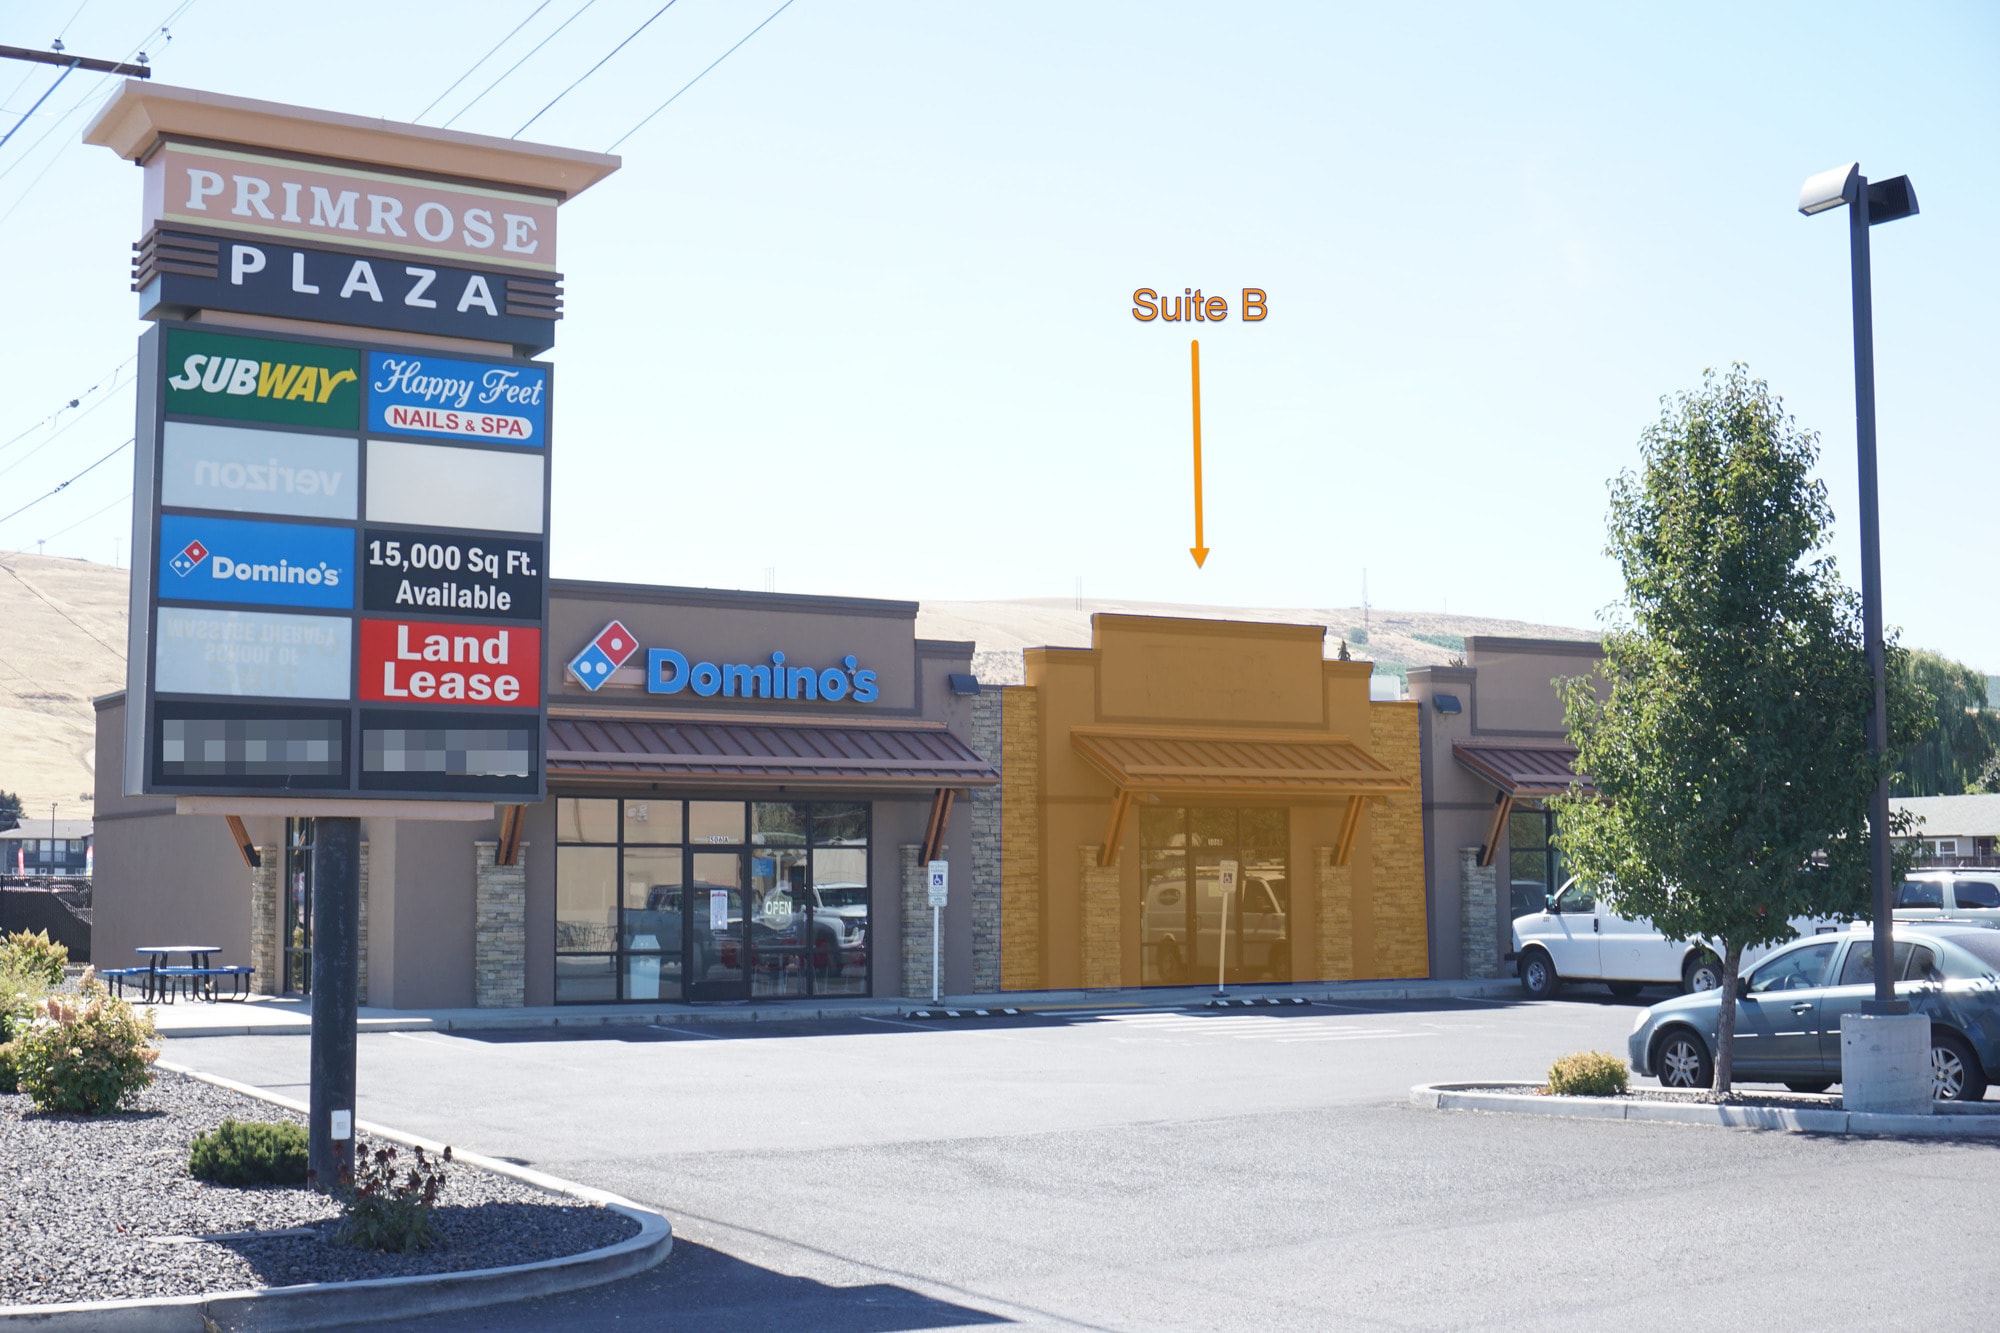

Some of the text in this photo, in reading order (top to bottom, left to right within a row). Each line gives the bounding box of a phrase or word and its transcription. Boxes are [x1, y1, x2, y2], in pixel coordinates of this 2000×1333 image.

[185, 167, 539, 255] PRIMROSE
[230, 244, 499, 317] PLAZA
[169, 354, 357, 403] SUBWAY
[374, 359, 543, 408] Happy Feet
[393, 407, 524, 437] NAILS & SPA
[212, 556, 340, 586] Domino's
[369, 540, 537, 579] 15,000 Sq Ft.
[395, 579, 511, 611] Available
[397, 624, 509, 664] Land
[383, 661, 520, 702] Lease
[645, 647, 880, 703] Domino's
[765, 900, 792, 915] OPEN
